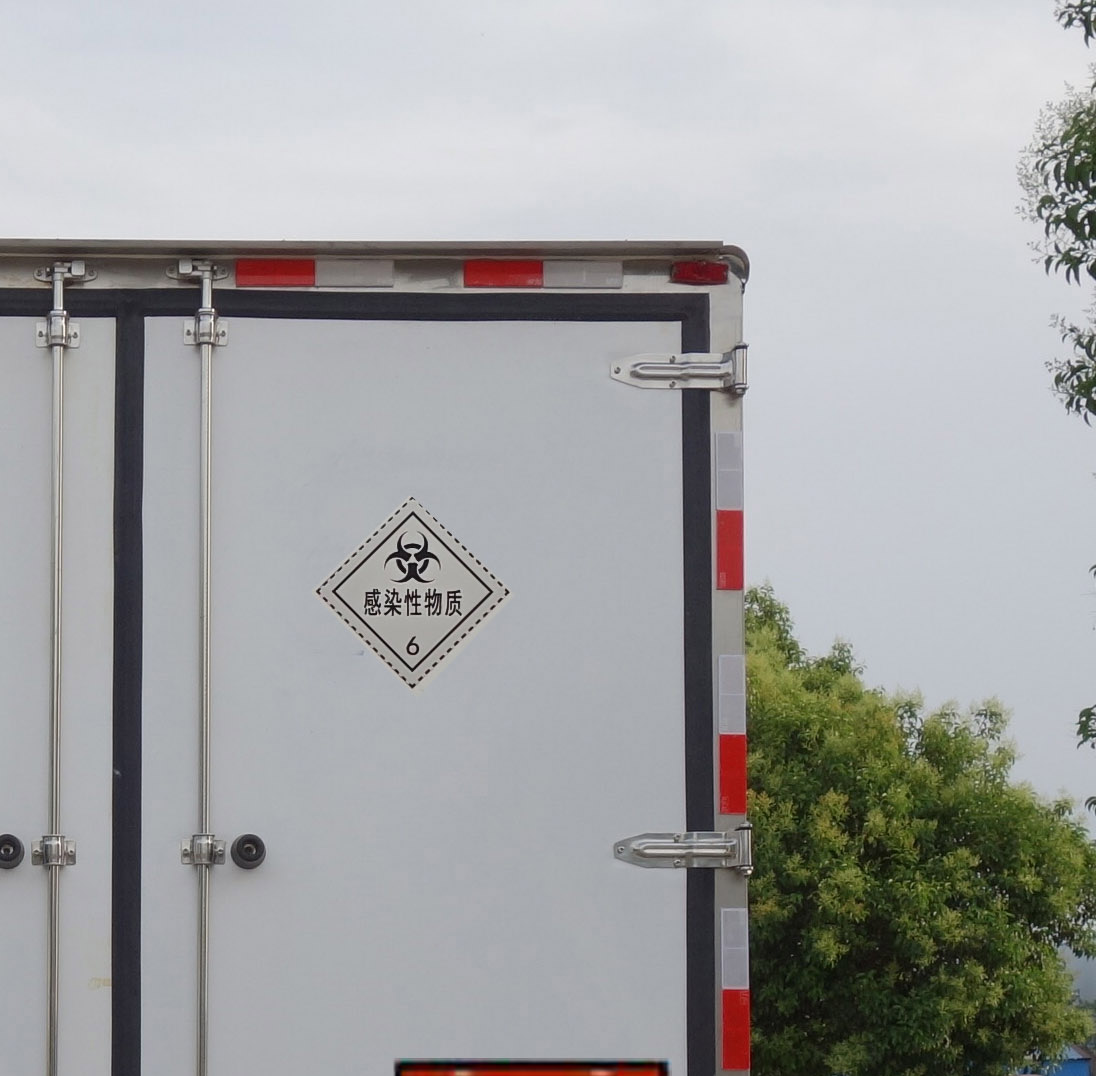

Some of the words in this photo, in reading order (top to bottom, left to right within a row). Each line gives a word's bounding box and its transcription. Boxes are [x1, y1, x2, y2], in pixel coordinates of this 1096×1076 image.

[363, 588, 463, 617] 感染性物质
[406, 635, 420, 656] 6
